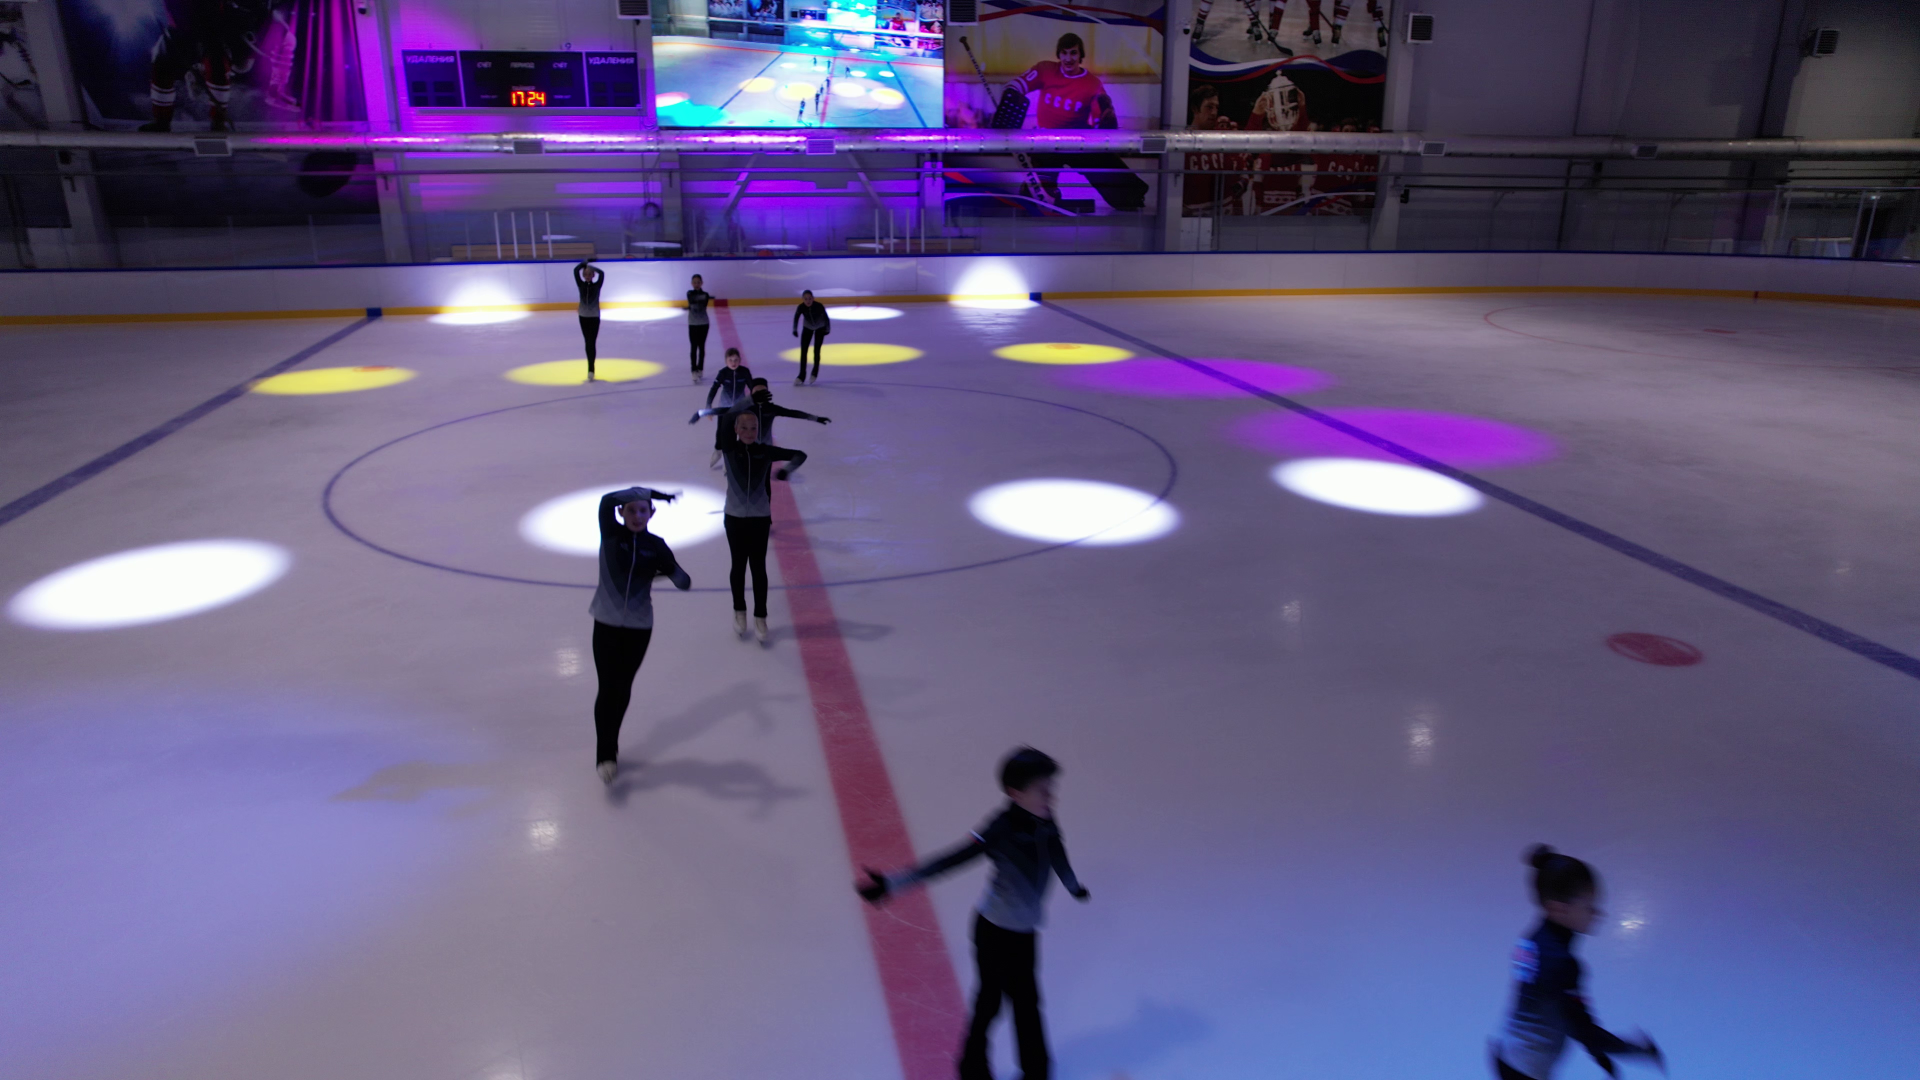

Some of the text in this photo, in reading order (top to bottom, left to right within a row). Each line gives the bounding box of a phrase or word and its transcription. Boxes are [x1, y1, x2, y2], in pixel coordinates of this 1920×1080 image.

[405, 55, 455, 64] УДАЛЕНИЯ
[588, 56, 635, 65] УДАЛЕНИЯ
[1044, 92, 1083, 112] СССР
